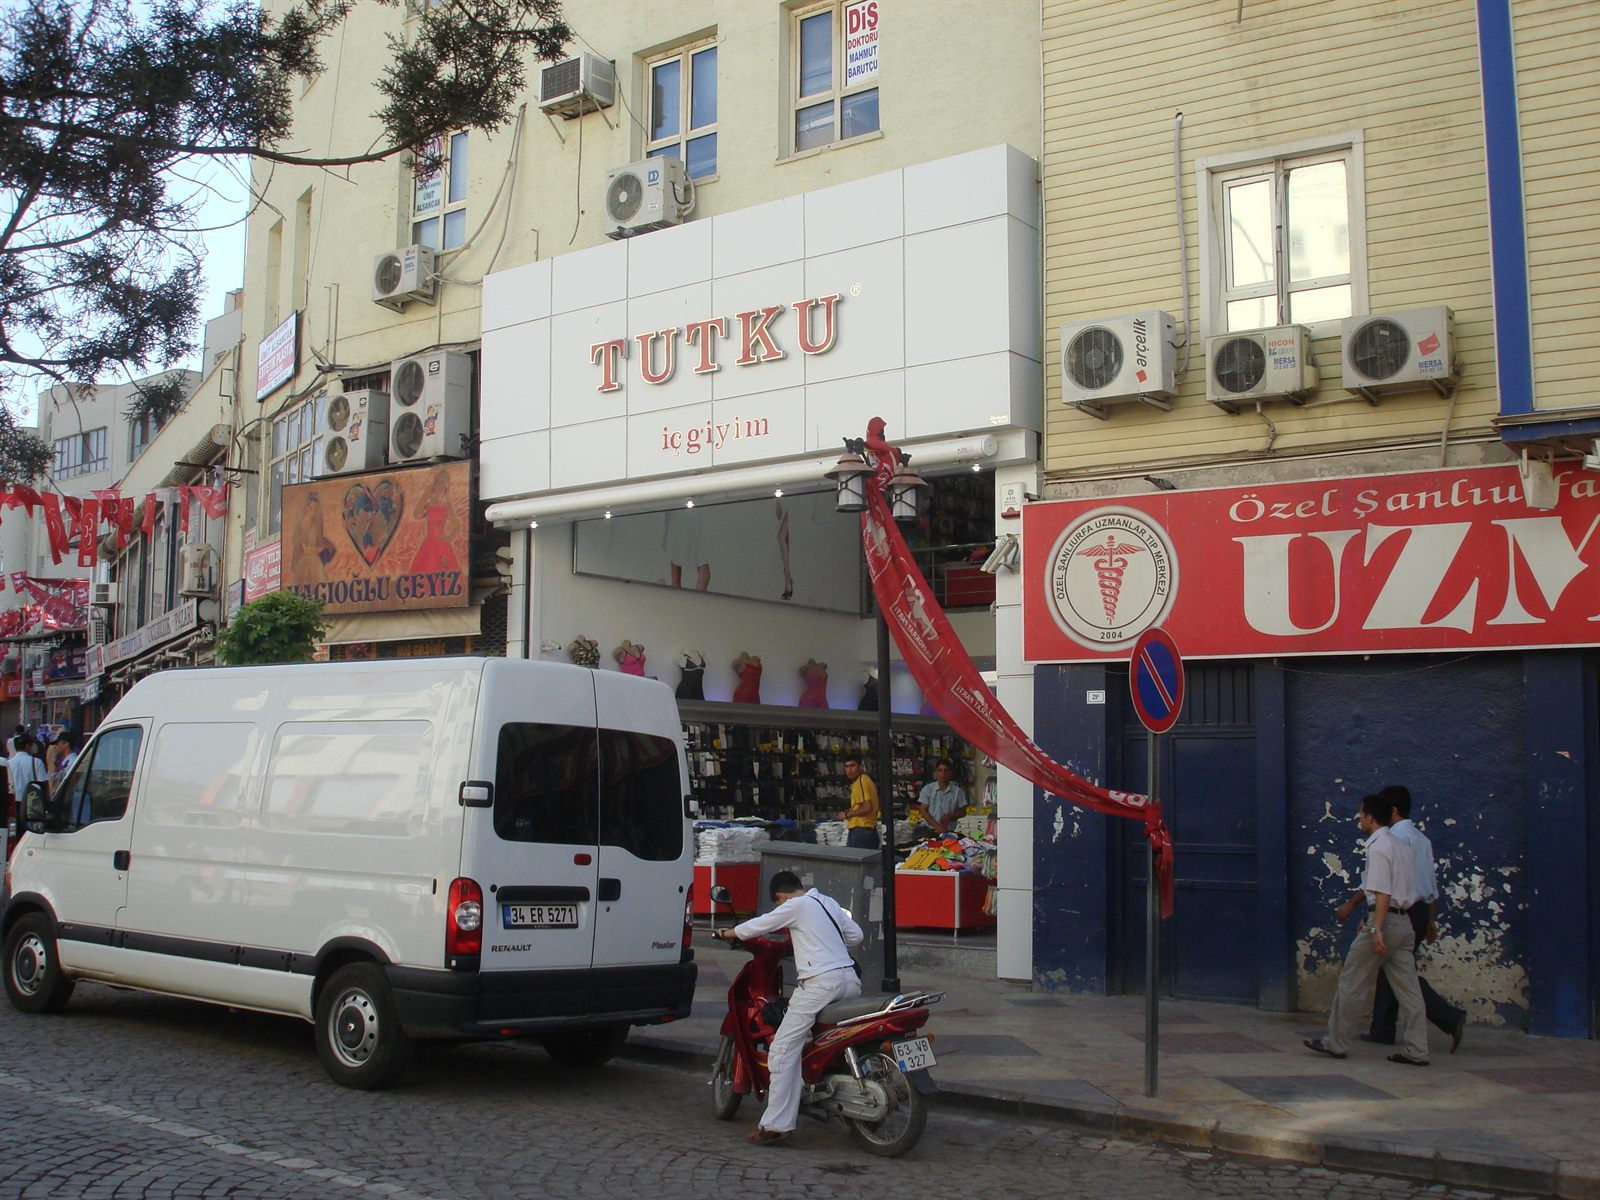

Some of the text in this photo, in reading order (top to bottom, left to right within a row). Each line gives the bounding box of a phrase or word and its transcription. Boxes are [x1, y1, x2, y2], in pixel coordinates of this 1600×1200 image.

[848, 31, 878, 50] DOKTORU
[849, 45, 877, 63] MAHMUT
[848, 60, 878, 78] BARUTÇU
[590, 293, 844, 393] TUTKU
[1133, 318, 1149, 367] arçelik
[1274, 356, 1296, 365] MERSA
[1418, 359, 1442, 369] MERSA
[1229, 470, 1600, 523] Özel Şanlıufa
[1095, 518, 1147, 537] UZMANLAR
[1058, 525, 1093, 571] ŞANLIURFA
[1145, 535, 1158, 550] TIP
[1056, 575, 1065, 600] ÖZEL
[1100, 631, 1123, 640] 2004
[512, 907, 573, 923] 34 ER 5271
[491, 944, 532, 952] RENAULT
[897, 1040, 929, 1056] 63 VB
[908, 1054, 926, 1067] 327
